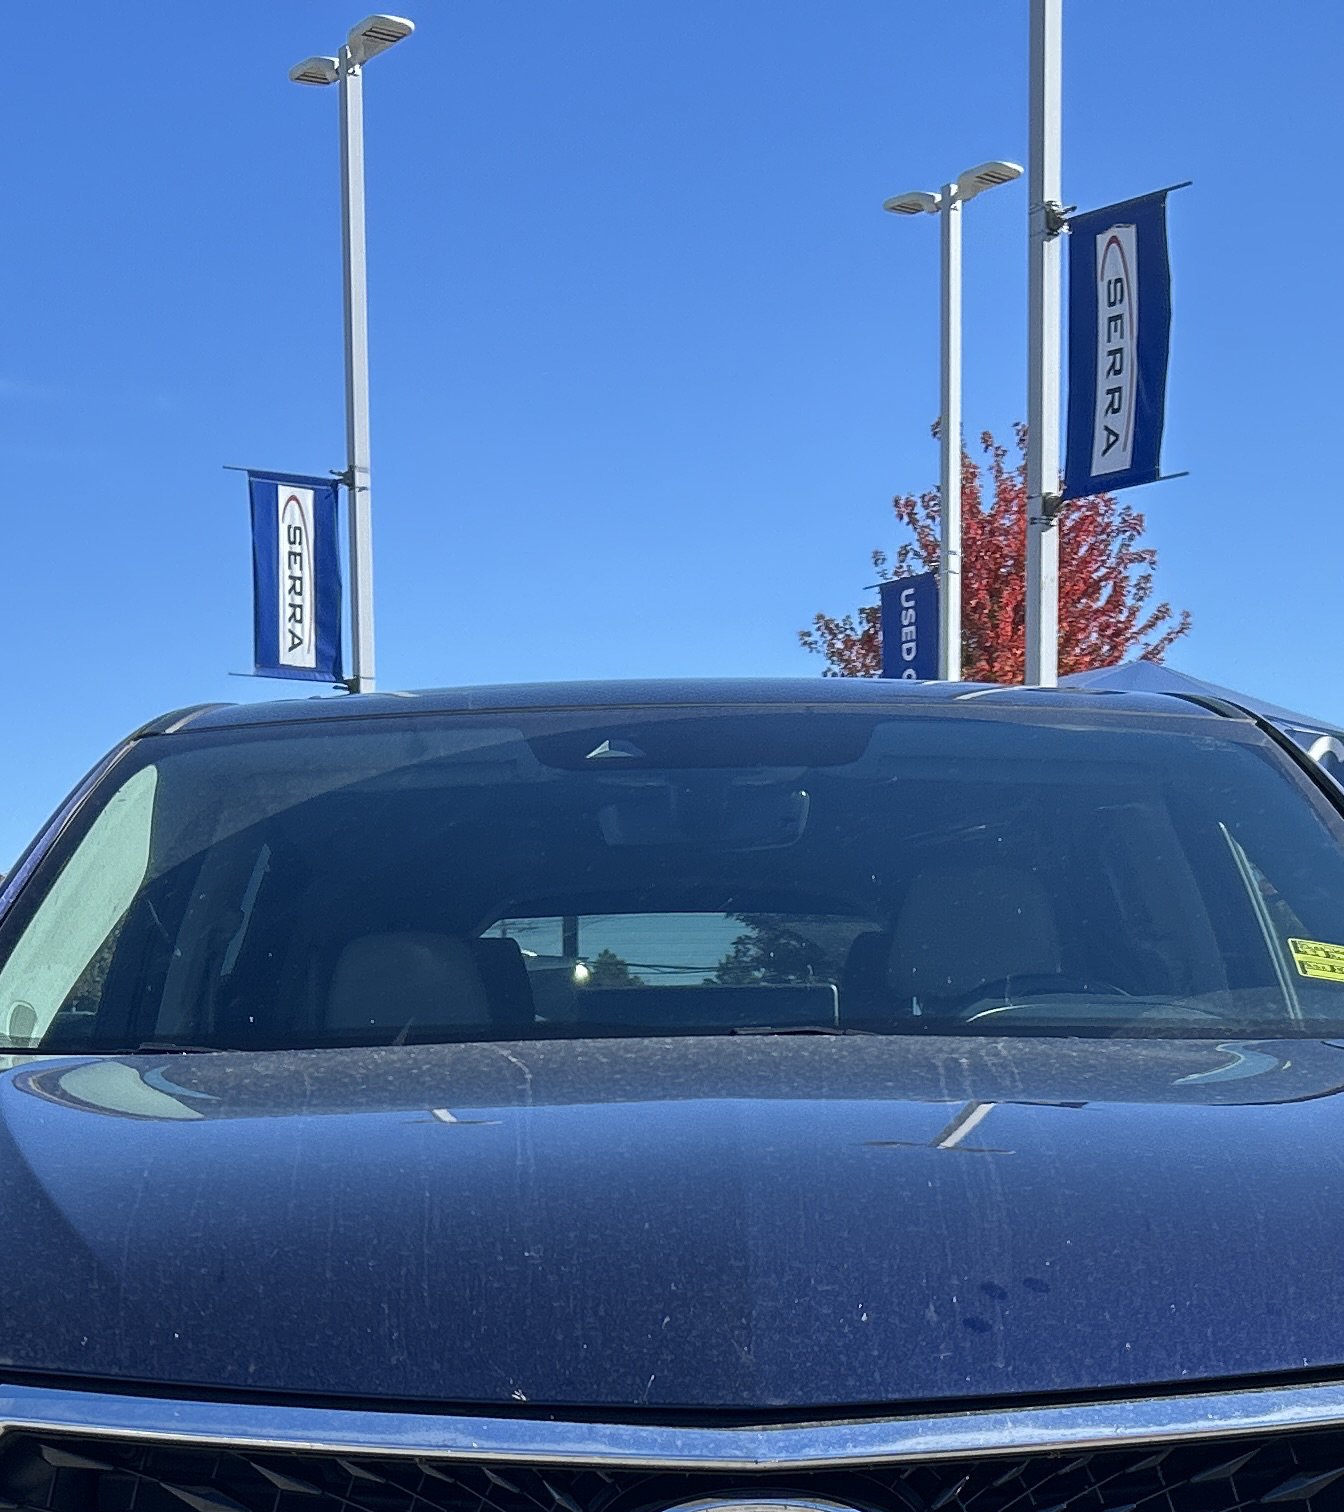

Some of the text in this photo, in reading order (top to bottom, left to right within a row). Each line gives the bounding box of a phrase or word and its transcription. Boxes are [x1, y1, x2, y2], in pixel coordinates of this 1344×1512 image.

[1101, 277, 1124, 457] SERRA
[287, 524, 303, 653] SERRA
[900, 588, 917, 661] USED
